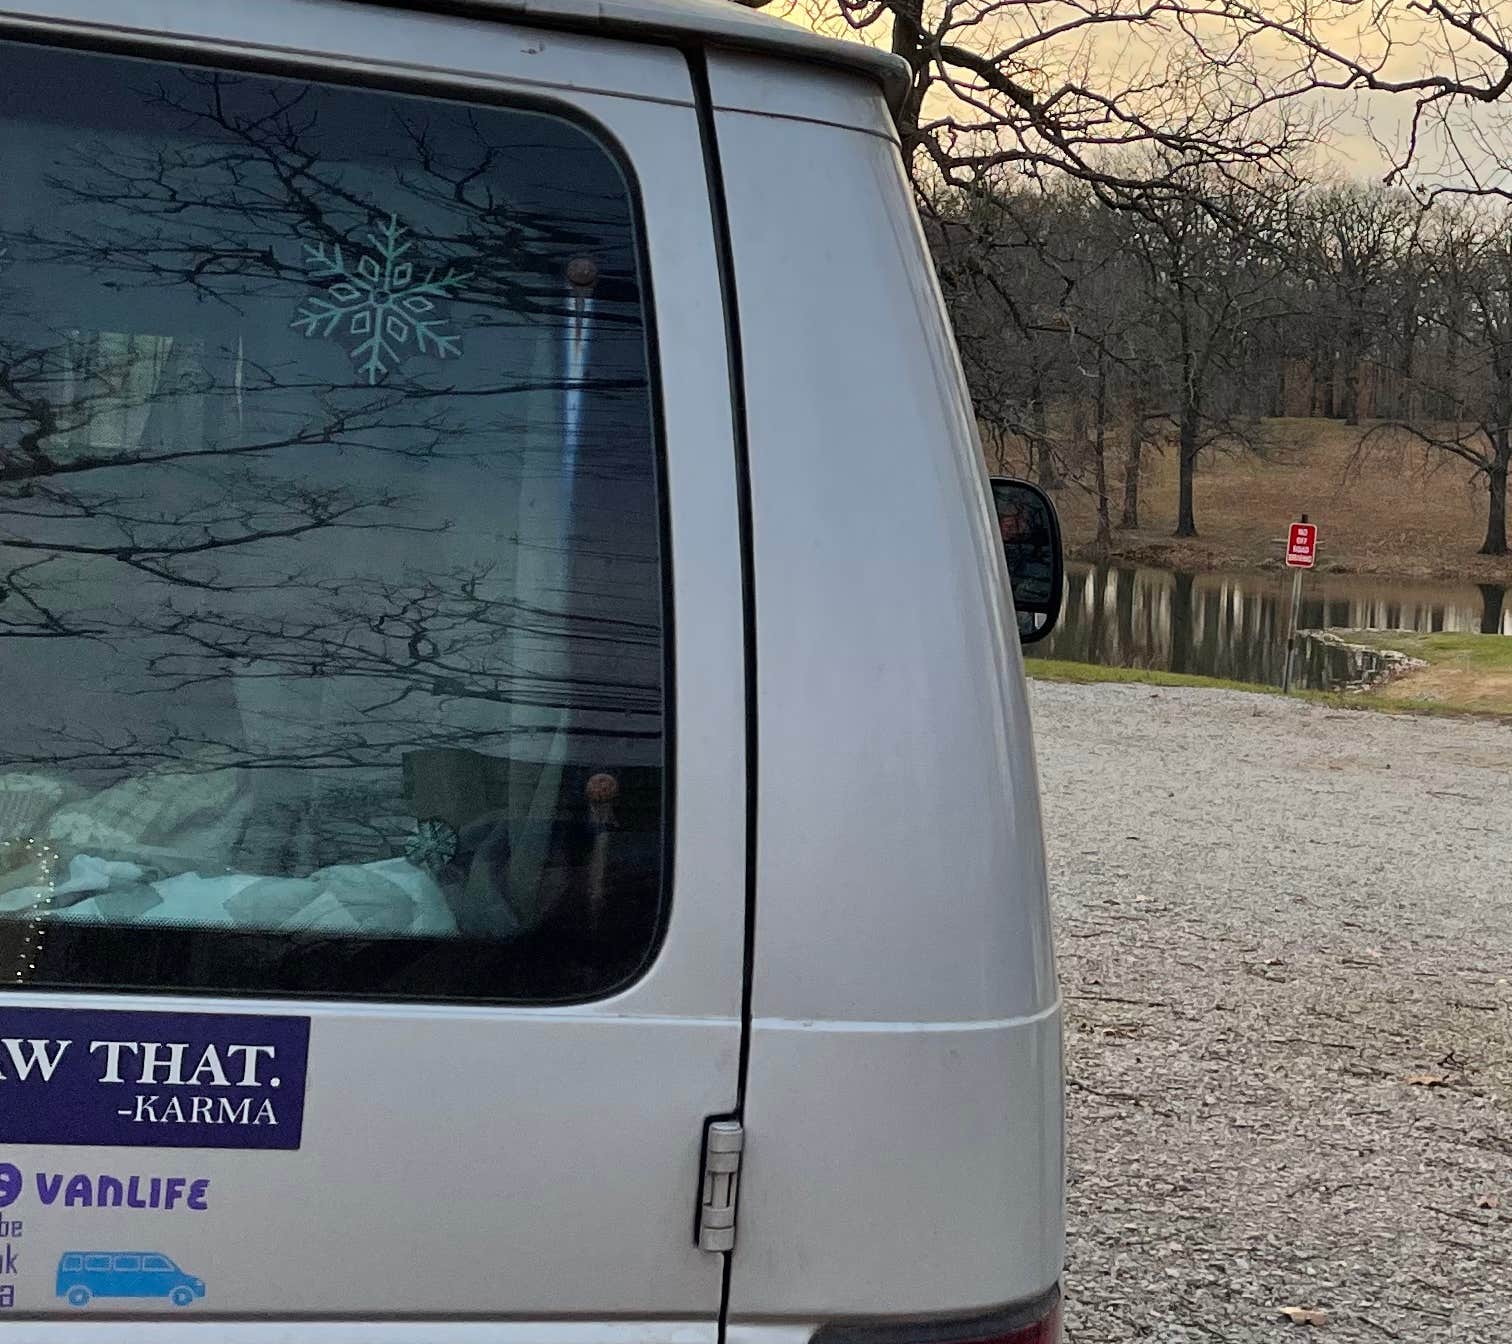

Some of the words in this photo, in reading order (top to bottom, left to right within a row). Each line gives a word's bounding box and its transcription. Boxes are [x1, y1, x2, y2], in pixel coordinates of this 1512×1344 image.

[0, 1038, 72, 1082] W
[89, 1040, 281, 1088] THAT.
[117, 1095, 279, 1125] -KARMA
[36, 1172, 210, 1210] VANLIFE
